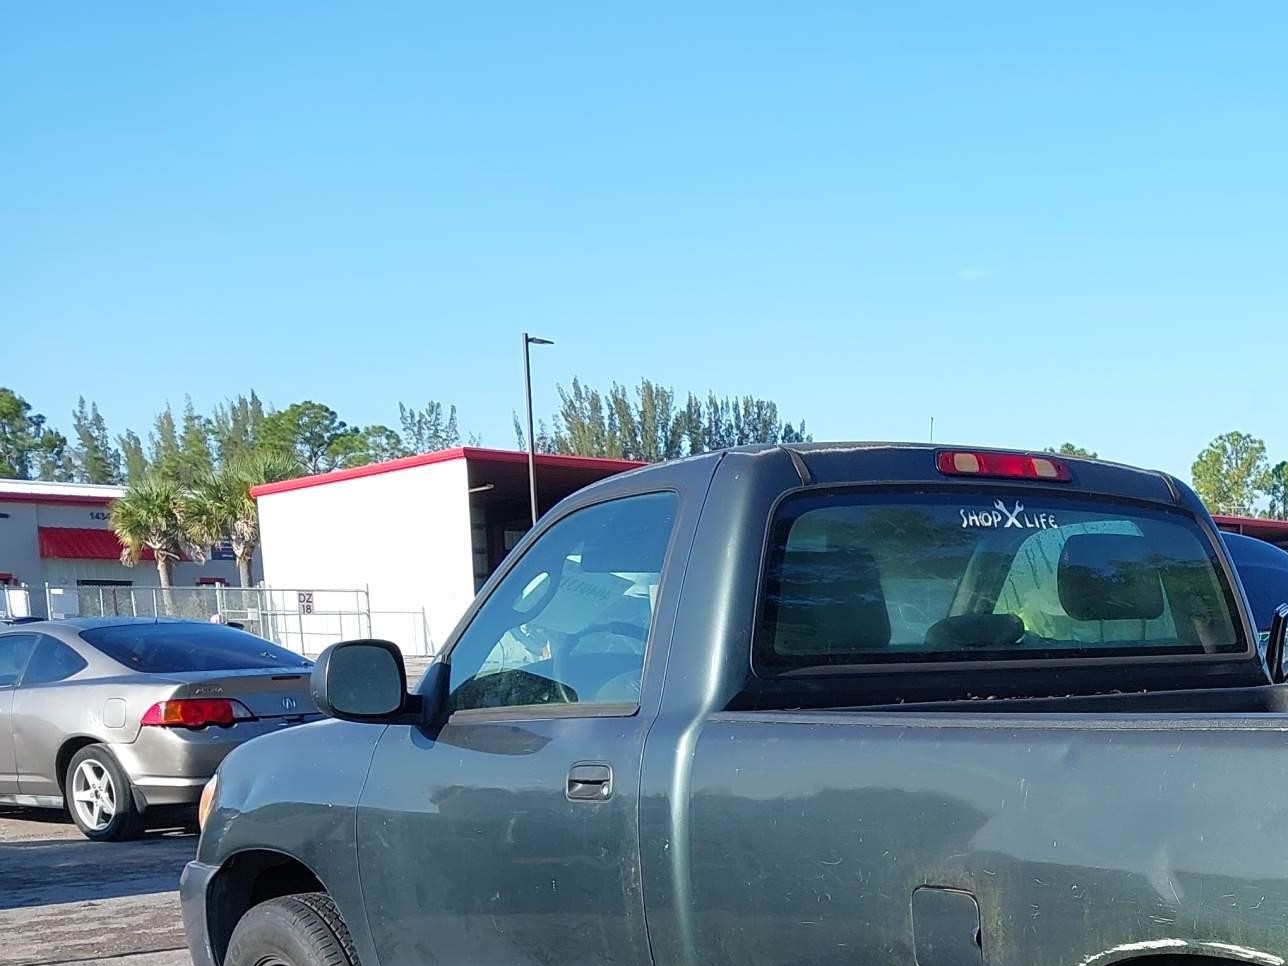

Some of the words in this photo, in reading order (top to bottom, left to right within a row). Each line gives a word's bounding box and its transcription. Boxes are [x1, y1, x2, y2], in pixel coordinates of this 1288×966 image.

[960, 508, 1002, 528] SHOP
[1024, 513, 1058, 529] LIFE
[299, 593, 312, 603] DZ
[302, 604, 312, 614] 18
